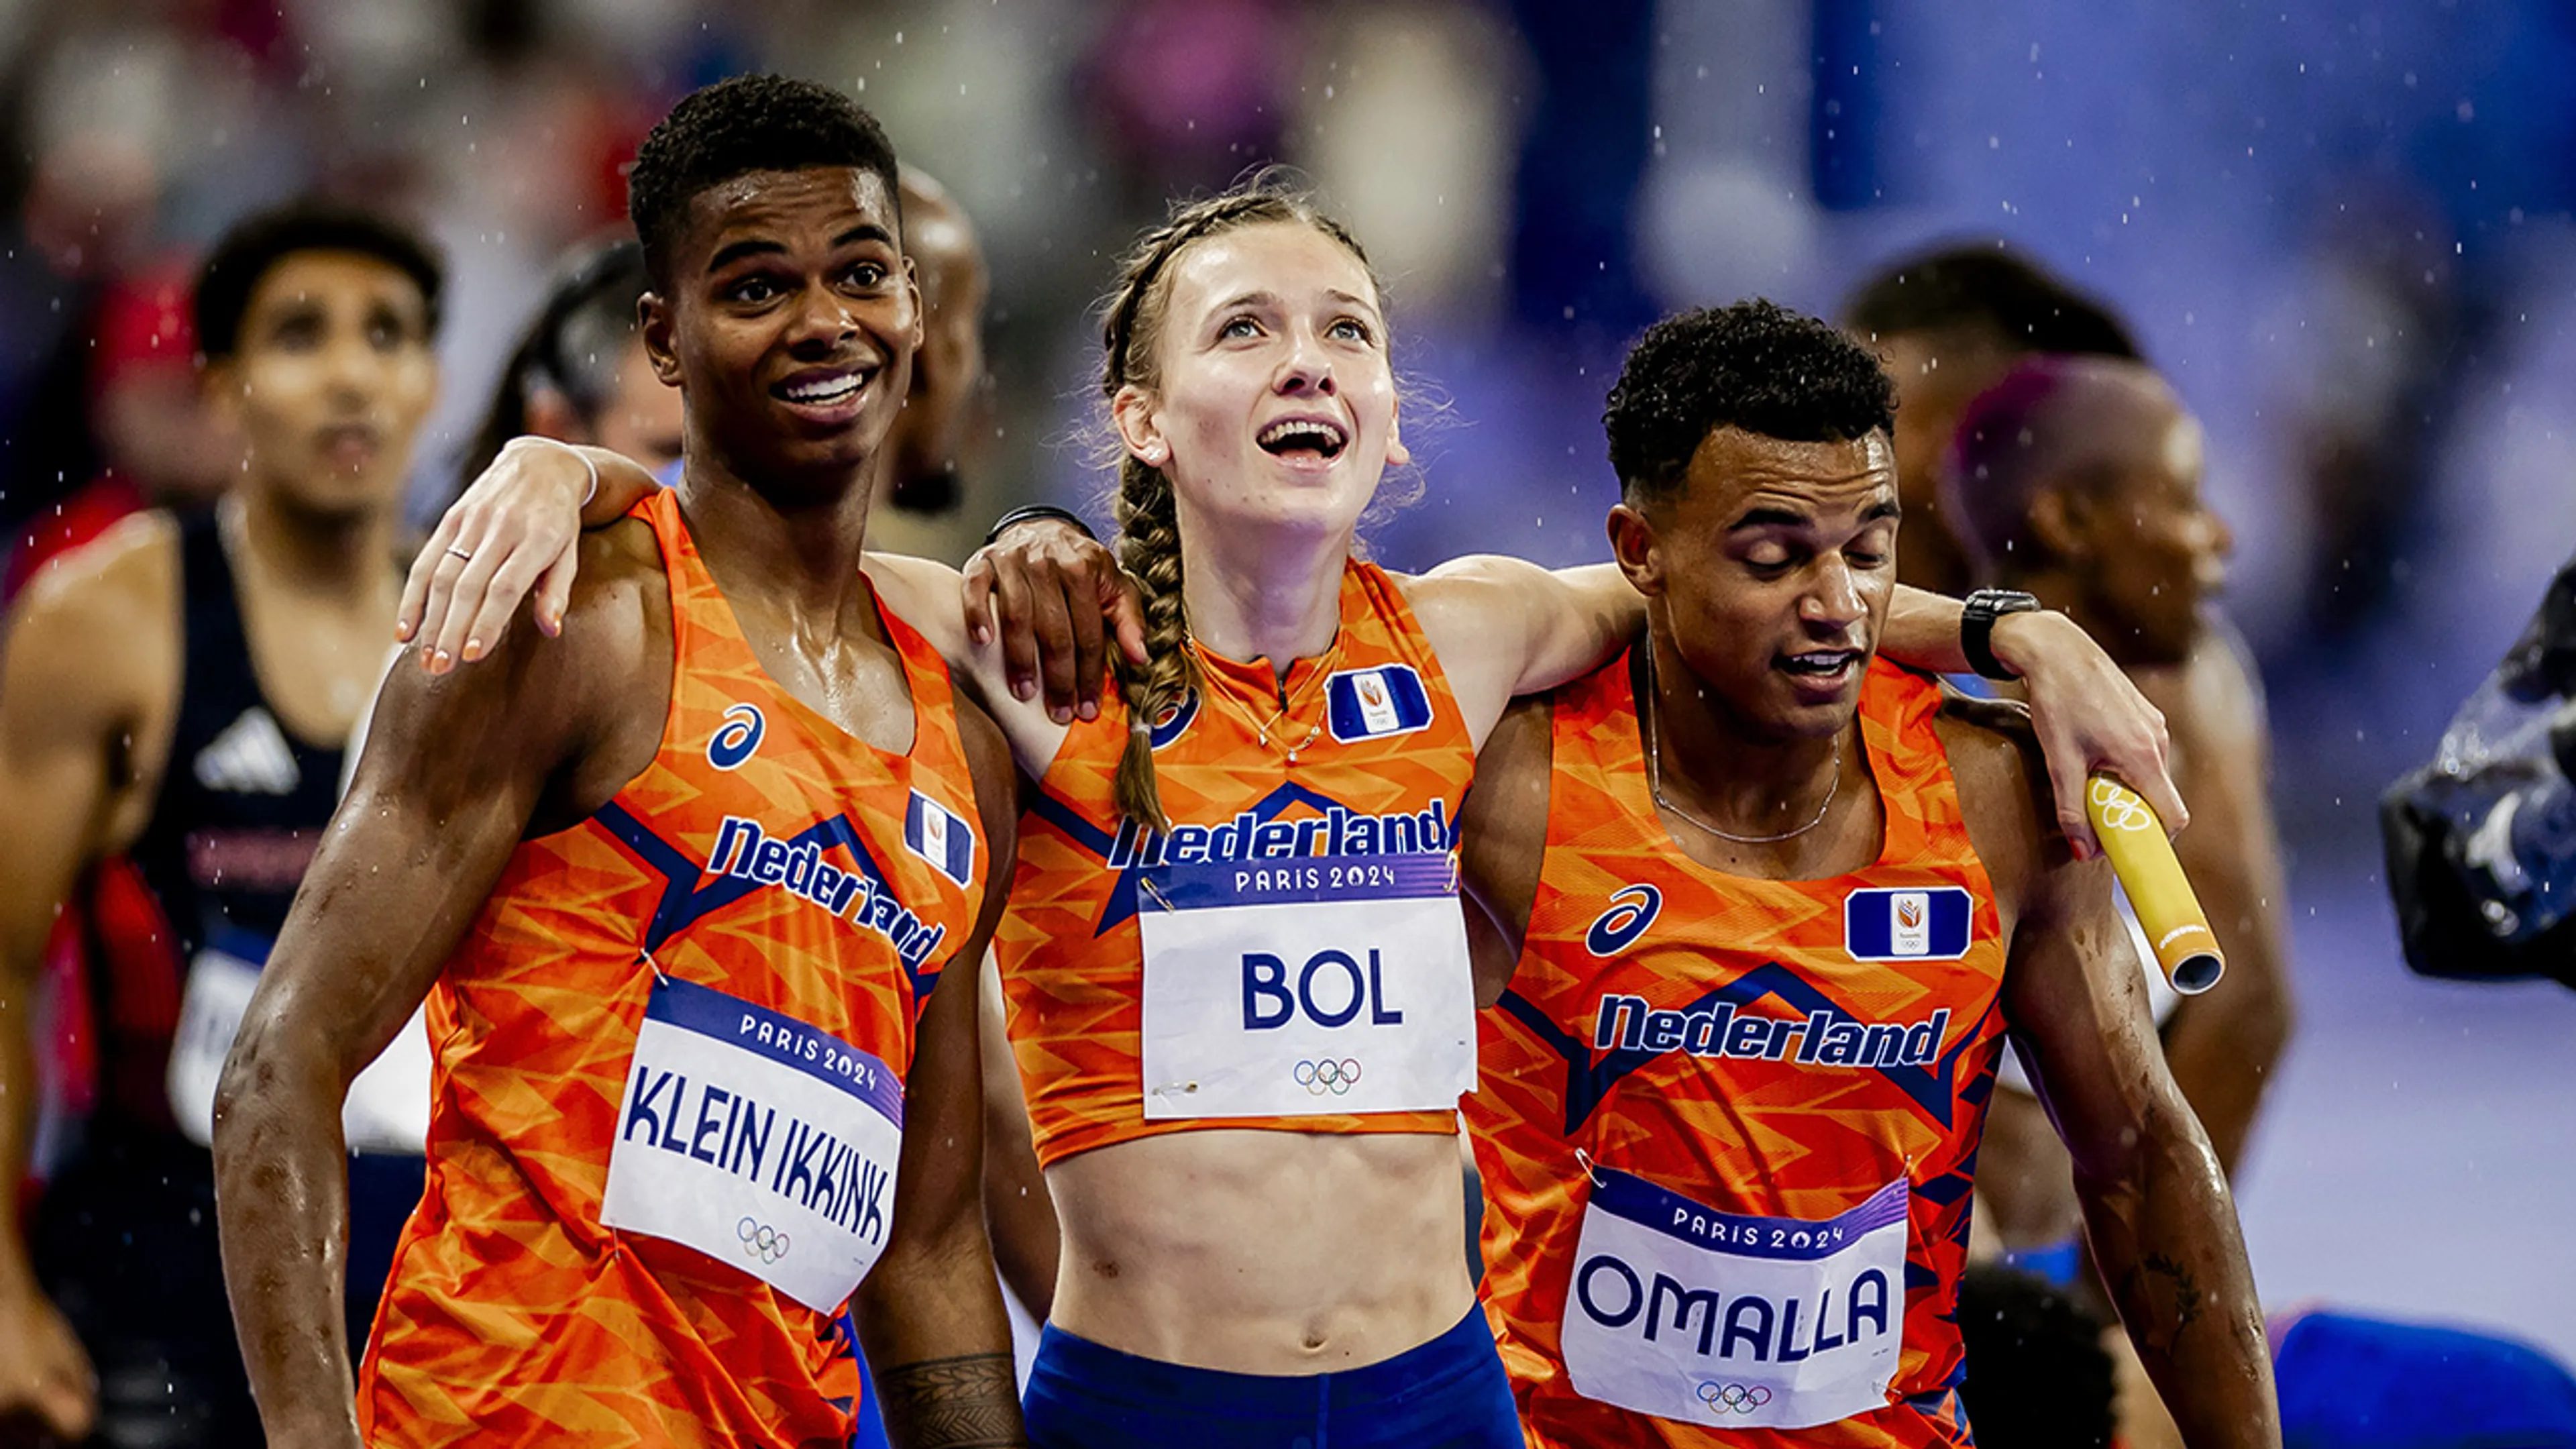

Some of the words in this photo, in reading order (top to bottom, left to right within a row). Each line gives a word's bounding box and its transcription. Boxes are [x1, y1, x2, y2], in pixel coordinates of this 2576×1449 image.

[1107, 798, 1450, 869] Nederland
[705, 815, 947, 969] Nederland
[1330, 867, 1395, 888] 2024
[1242, 949, 1403, 1030] BOL
[1595, 994, 1951, 1068] Nederland
[823, 1046, 877, 1091] 2024
[623, 1065, 776, 1183] KLEIN
[772, 1118, 888, 1245] IKKINK
[1770, 1226, 1843, 1249] 2024
[1577, 1255, 1888, 1362] OMALLA
